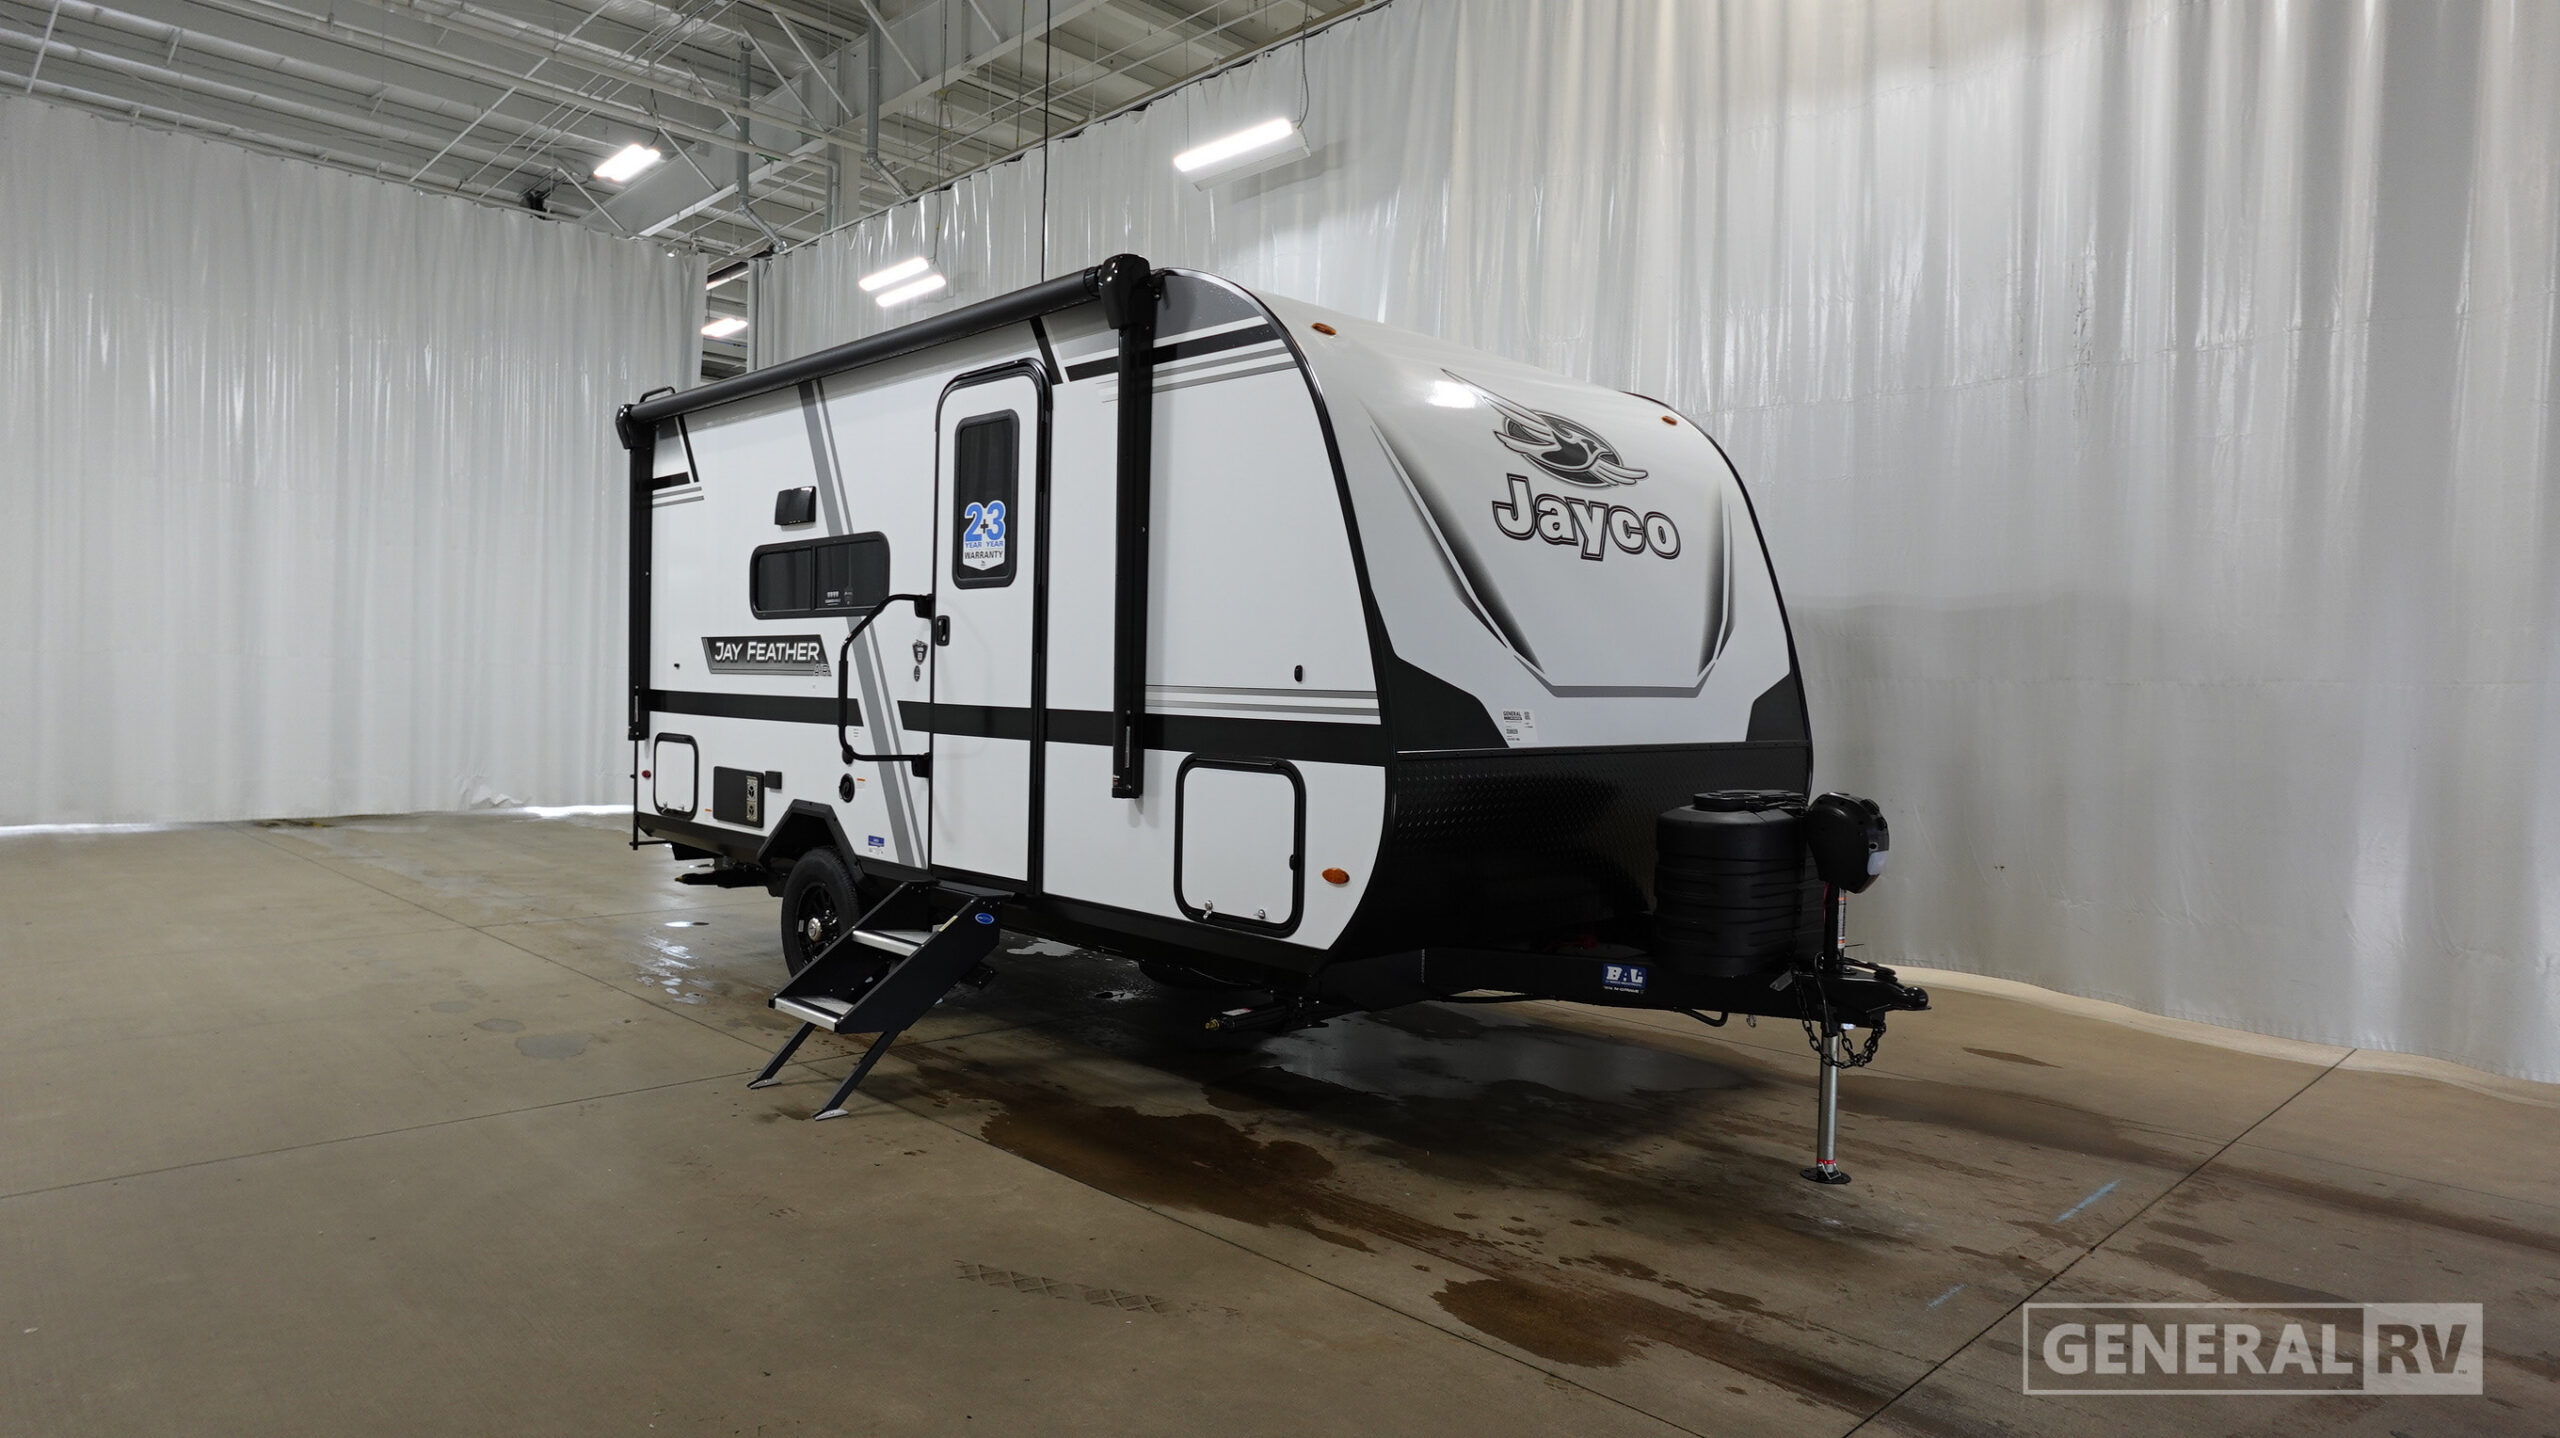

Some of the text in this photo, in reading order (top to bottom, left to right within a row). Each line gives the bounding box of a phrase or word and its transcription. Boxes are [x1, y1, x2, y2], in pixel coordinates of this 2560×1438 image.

[1492, 473, 1681, 561] Jayco
[965, 551, 1003, 559] WARRANTY
[714, 641, 820, 661] JAY FEATHER
